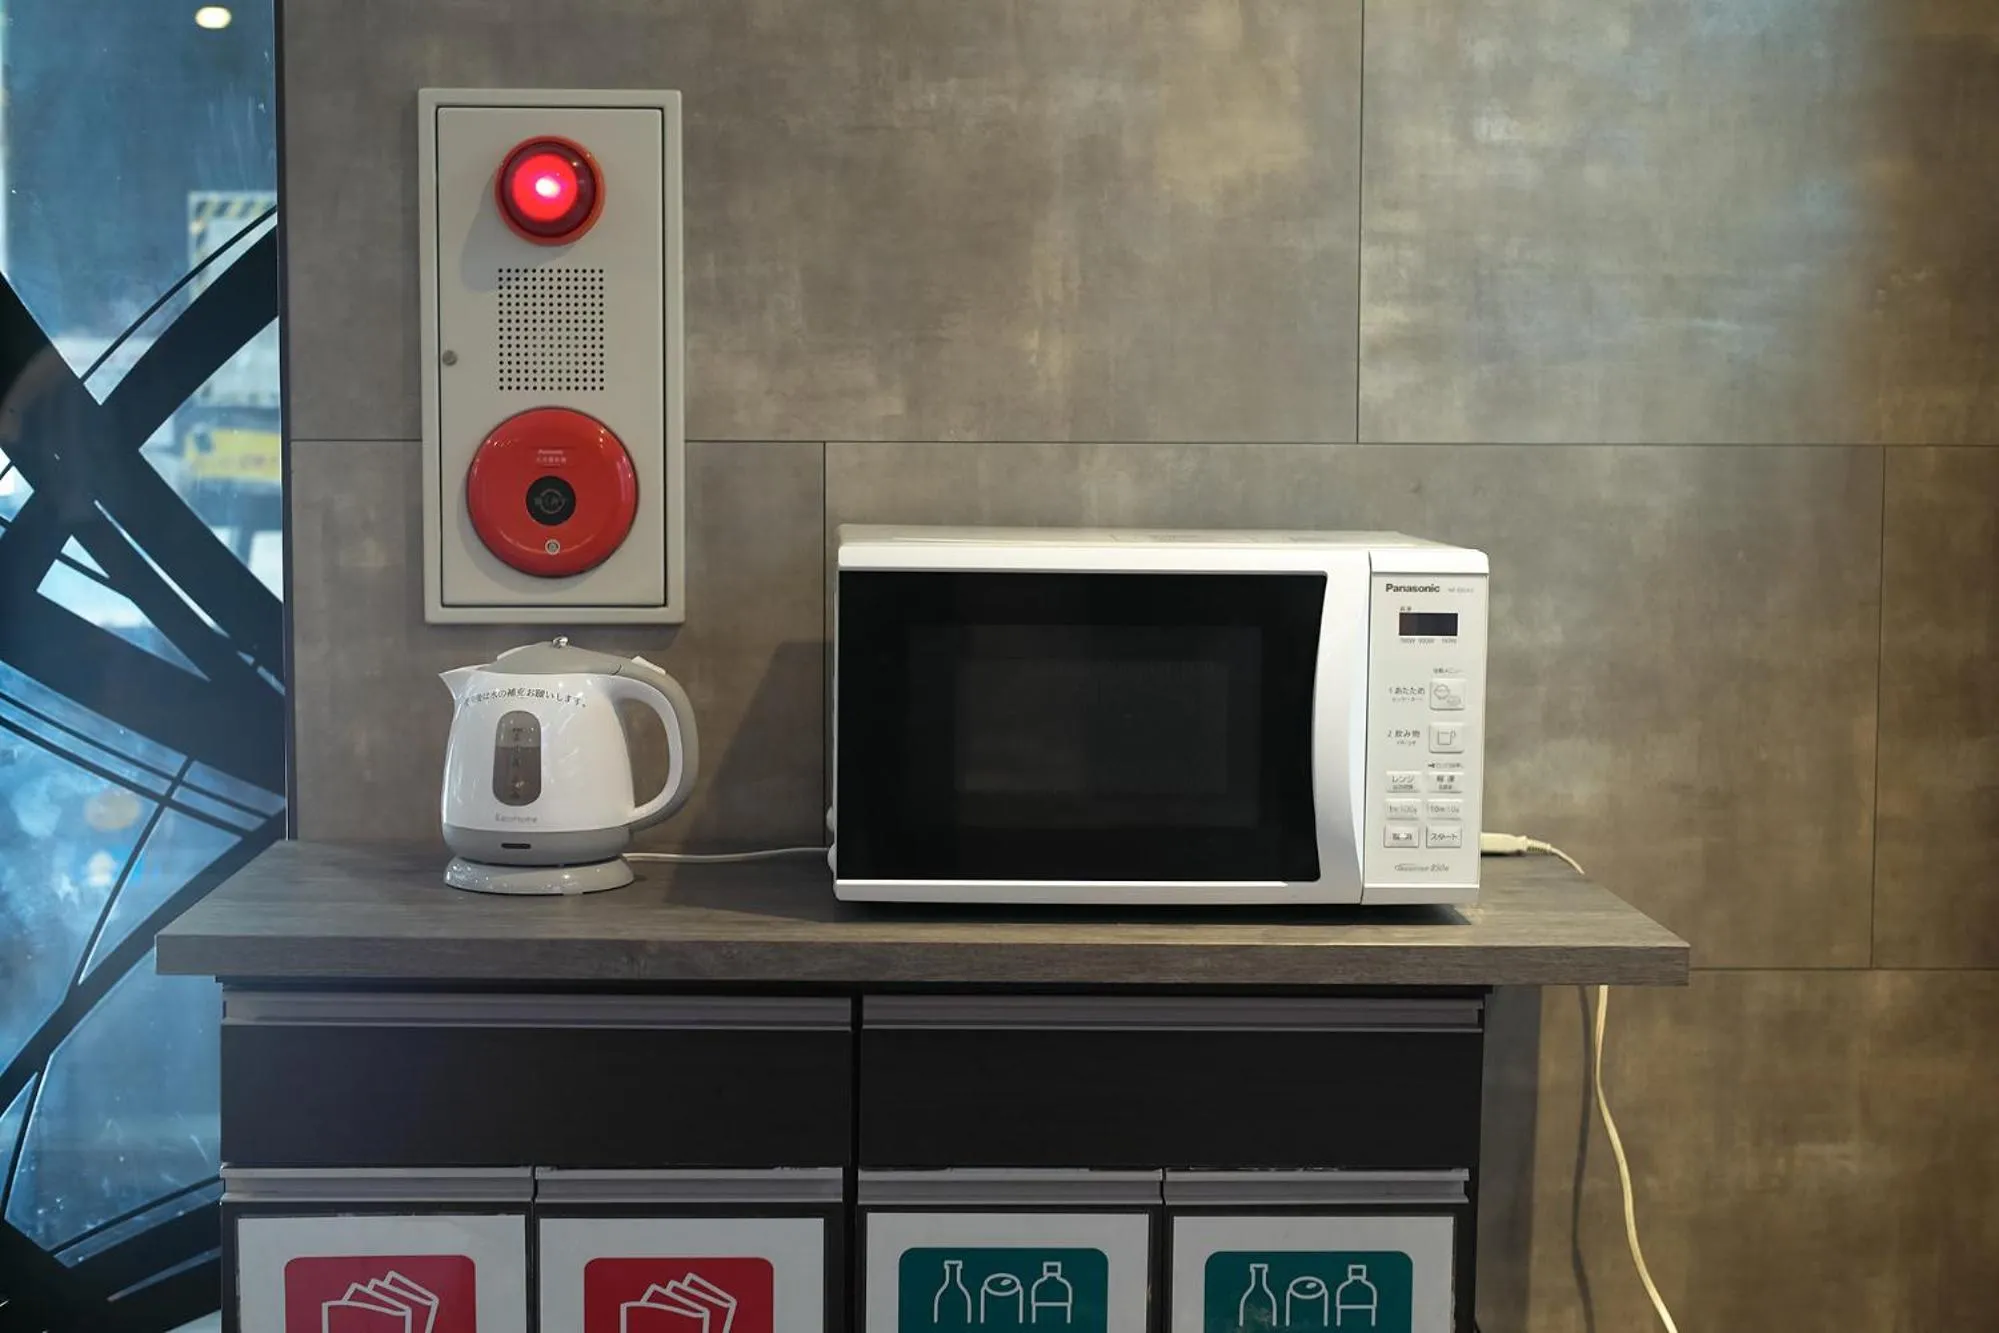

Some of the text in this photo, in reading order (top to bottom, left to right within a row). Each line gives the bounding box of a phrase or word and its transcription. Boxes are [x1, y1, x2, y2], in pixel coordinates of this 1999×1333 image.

[1385, 583, 1440, 593] Panasonic
[1395, 686, 1426, 695] あたため
[1430, 832, 1458, 841] スタート
